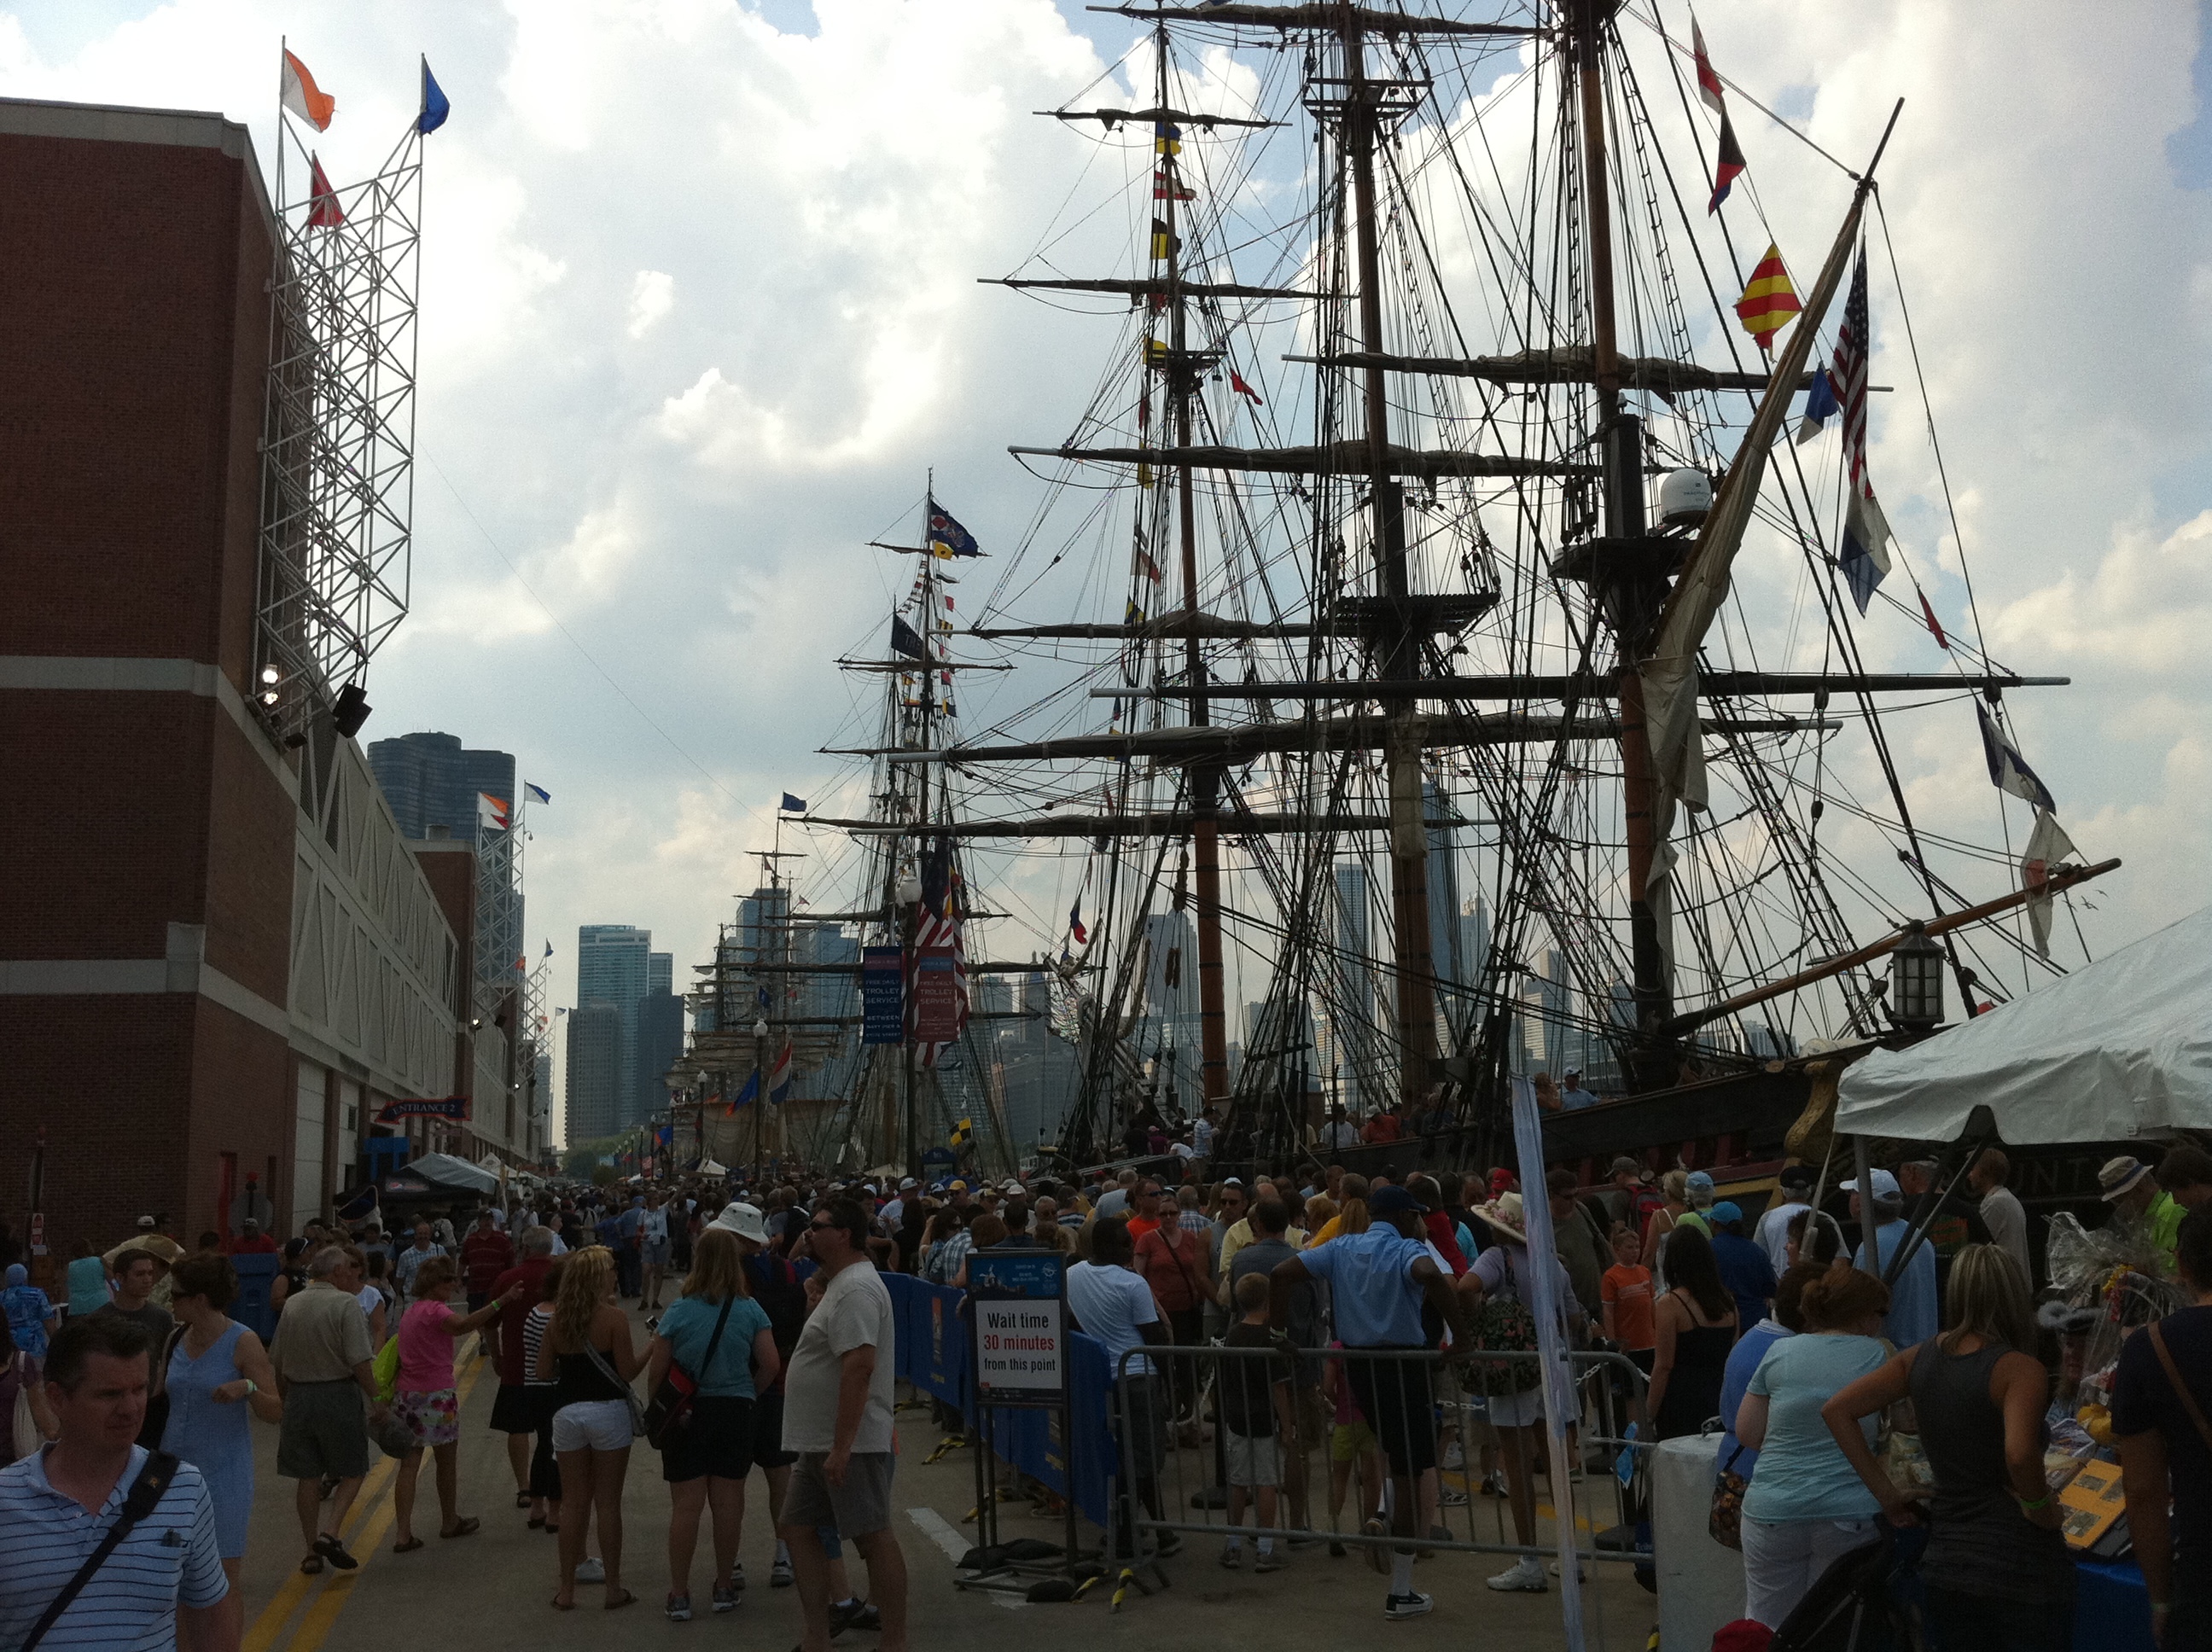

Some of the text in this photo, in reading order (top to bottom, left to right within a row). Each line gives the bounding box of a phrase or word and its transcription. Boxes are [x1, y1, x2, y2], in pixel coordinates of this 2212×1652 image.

[393, 1103, 457, 1115] ENTRANCE 2
[987, 1312, 1049, 1329] Wait time
[984, 1334, 1055, 1351] 30 minutes
[984, 1358, 1056, 1374] from this point
